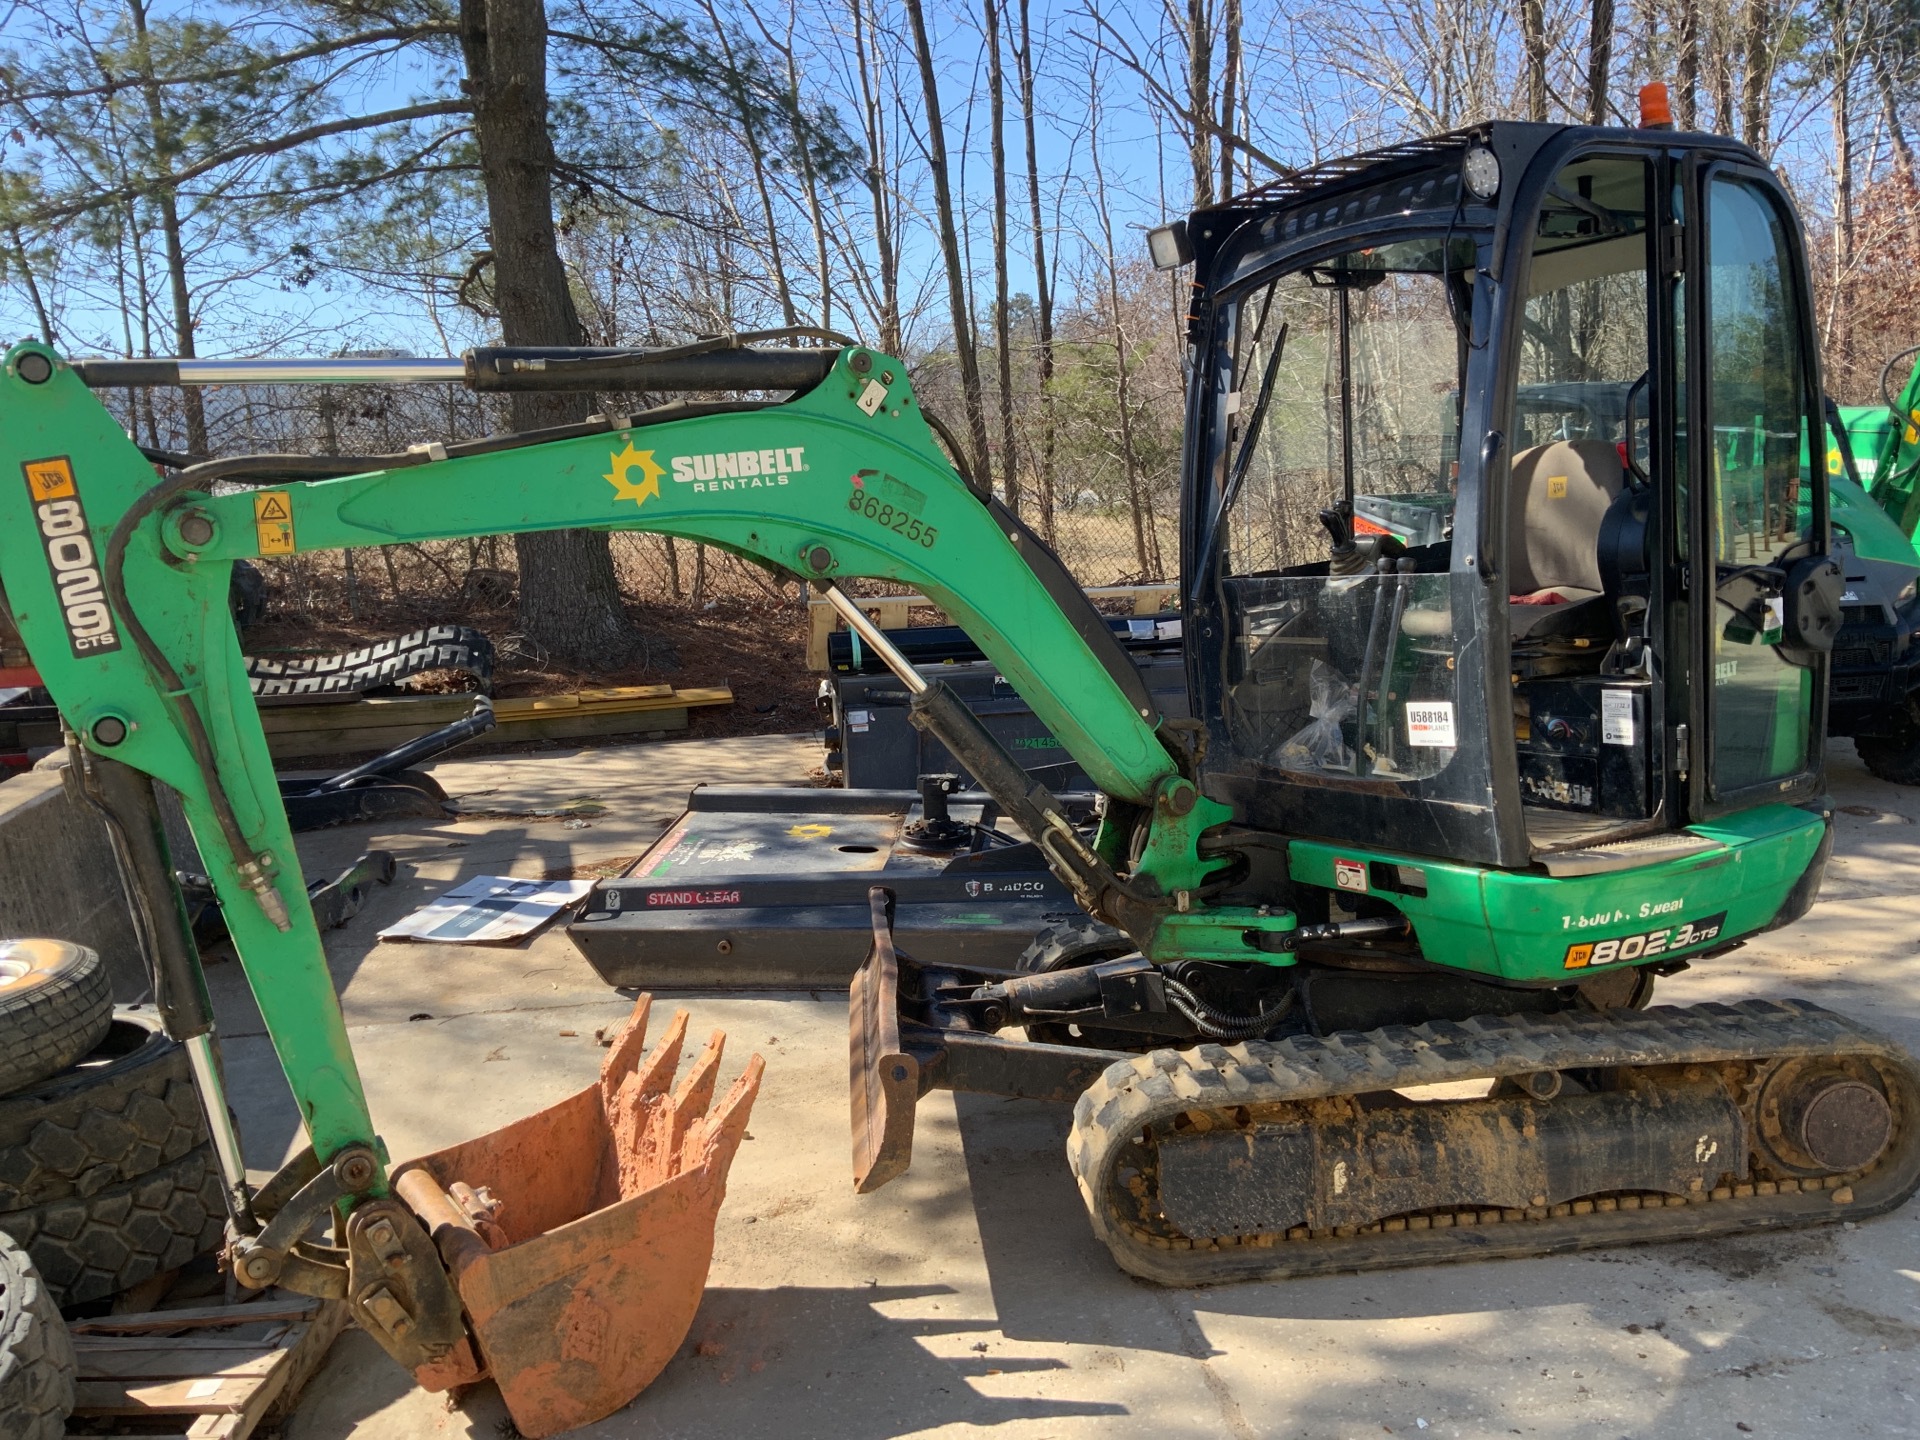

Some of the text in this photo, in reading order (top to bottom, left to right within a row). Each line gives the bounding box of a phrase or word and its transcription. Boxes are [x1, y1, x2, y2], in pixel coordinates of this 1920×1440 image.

[671, 447, 804, 482] SUNBELT
[39, 472, 65, 490] JCB
[694, 475, 789, 493] RENTALS
[849, 489, 937, 548] 868255
[37, 500, 111, 638] 8029
[75, 632, 115, 650] CTS
[1410, 711, 1449, 723] U588184
[649, 890, 740, 905] STAND CLEAR
[1689, 925, 1719, 944] CTS
